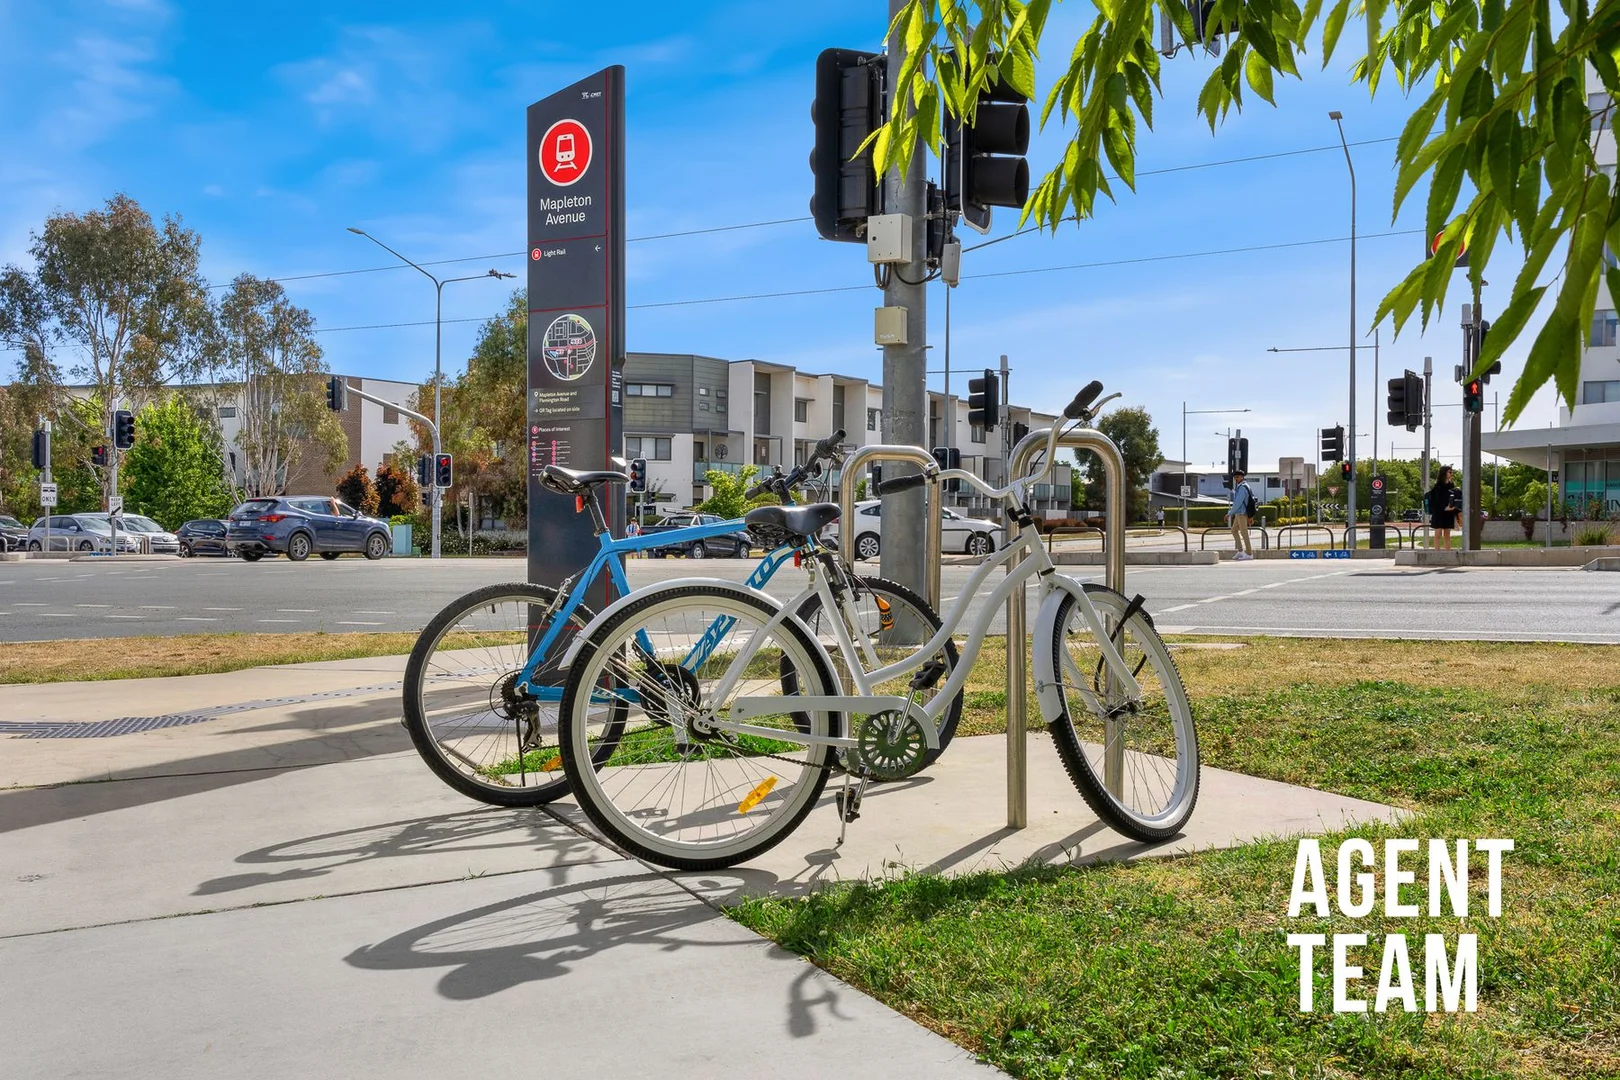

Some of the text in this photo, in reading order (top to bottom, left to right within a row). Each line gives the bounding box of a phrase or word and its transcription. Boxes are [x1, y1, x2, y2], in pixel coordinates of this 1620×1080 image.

[540, 195, 592, 212] Mapleton
[545, 212, 586, 226] Avenue
[543, 250, 556, 258] Light
